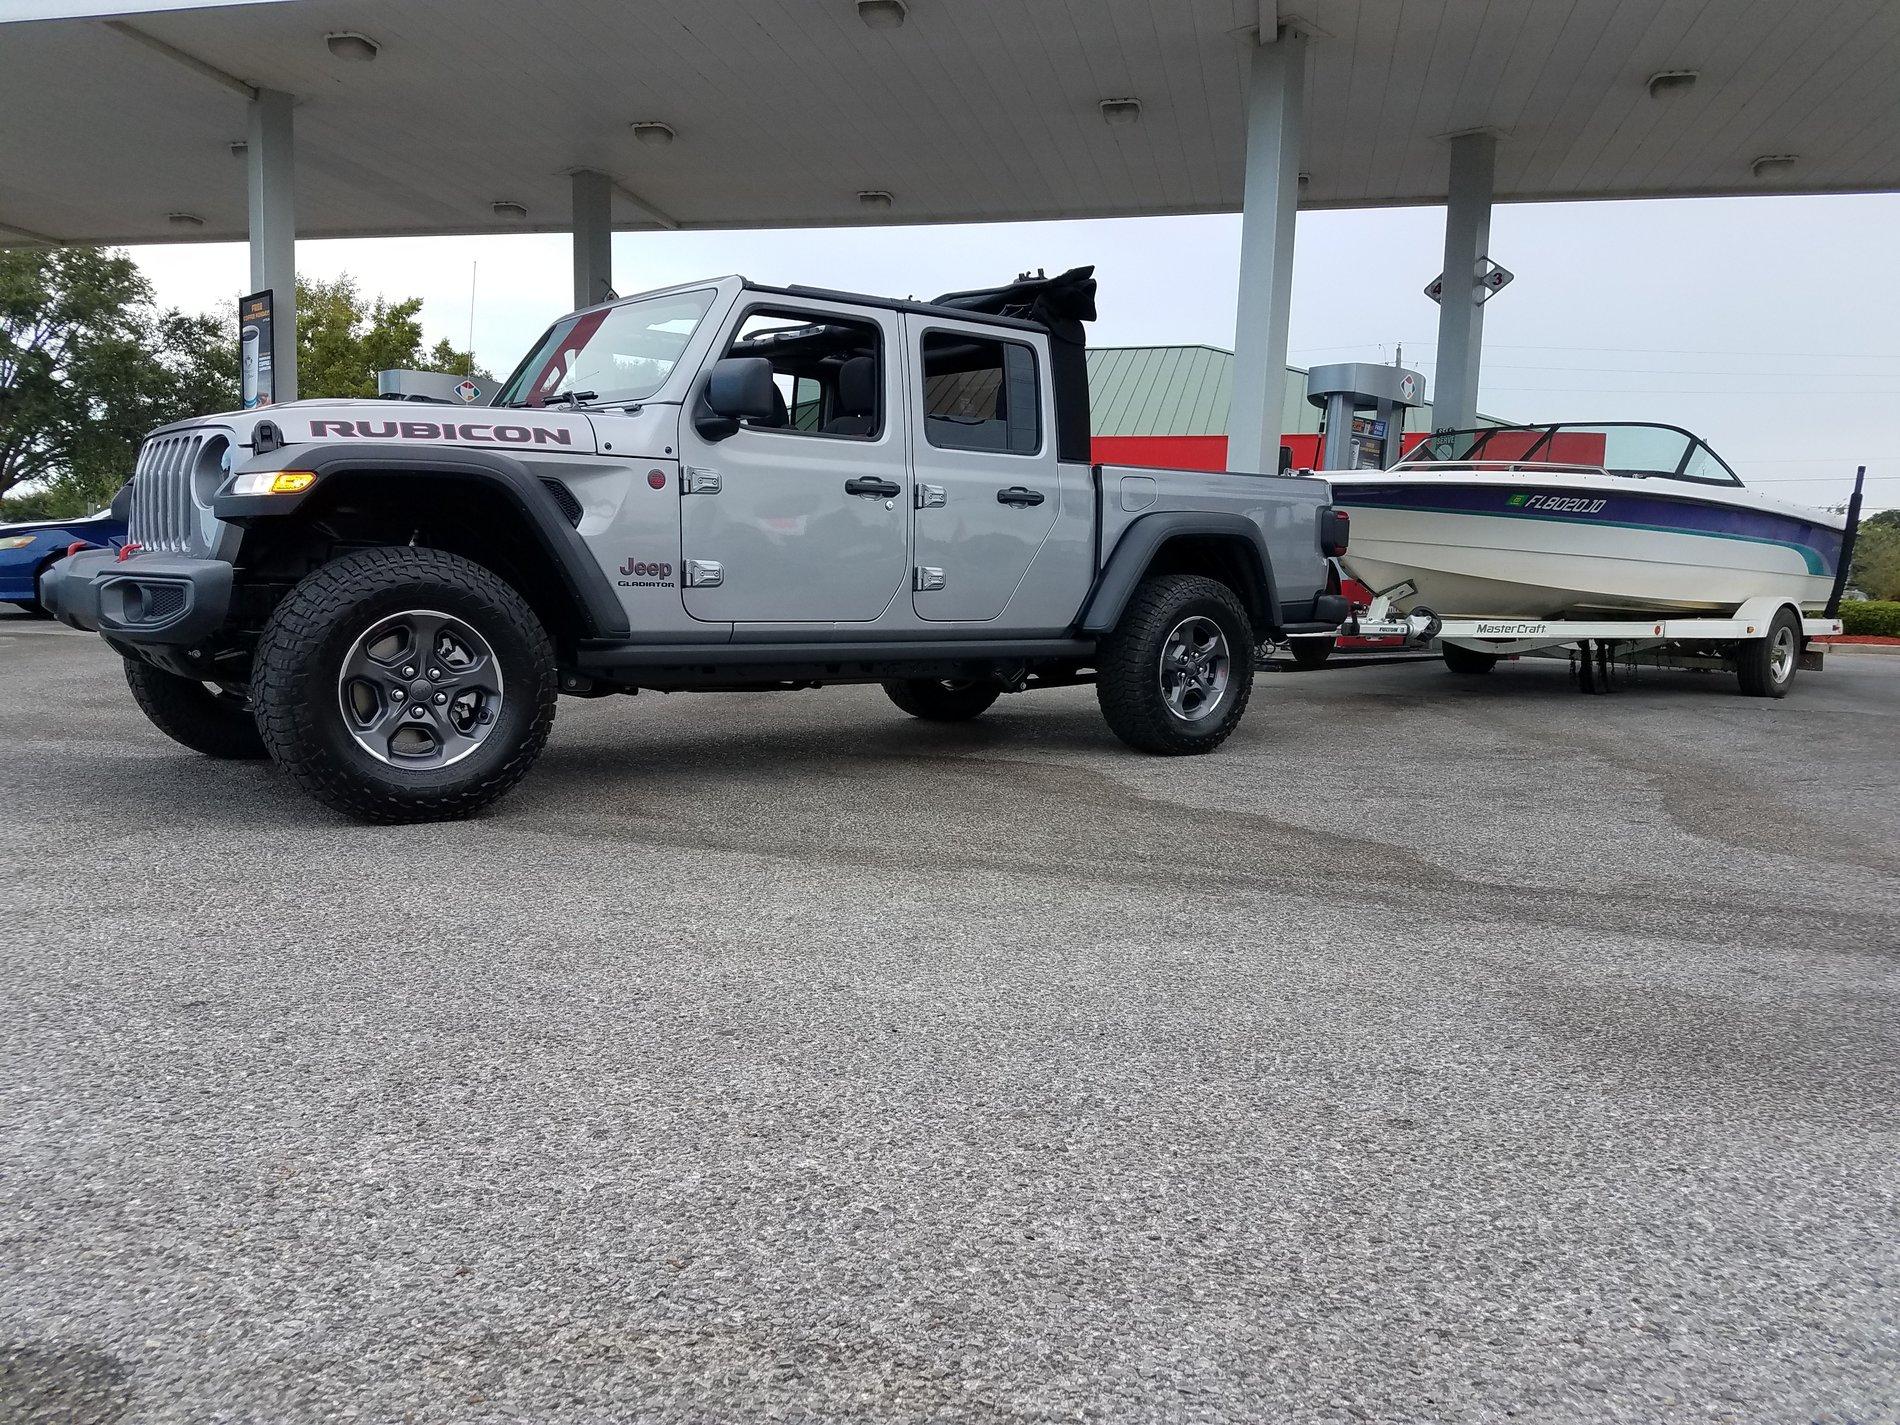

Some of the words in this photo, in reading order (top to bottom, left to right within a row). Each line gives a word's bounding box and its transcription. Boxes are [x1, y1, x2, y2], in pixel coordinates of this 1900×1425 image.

[1492, 272, 1503, 285] 3
[309, 420, 572, 446] RUBICON
[619, 557, 673, 581] Jeep
[617, 580, 675, 588] GLADIATOR
[1476, 623, 1547, 635] MasterCraft
